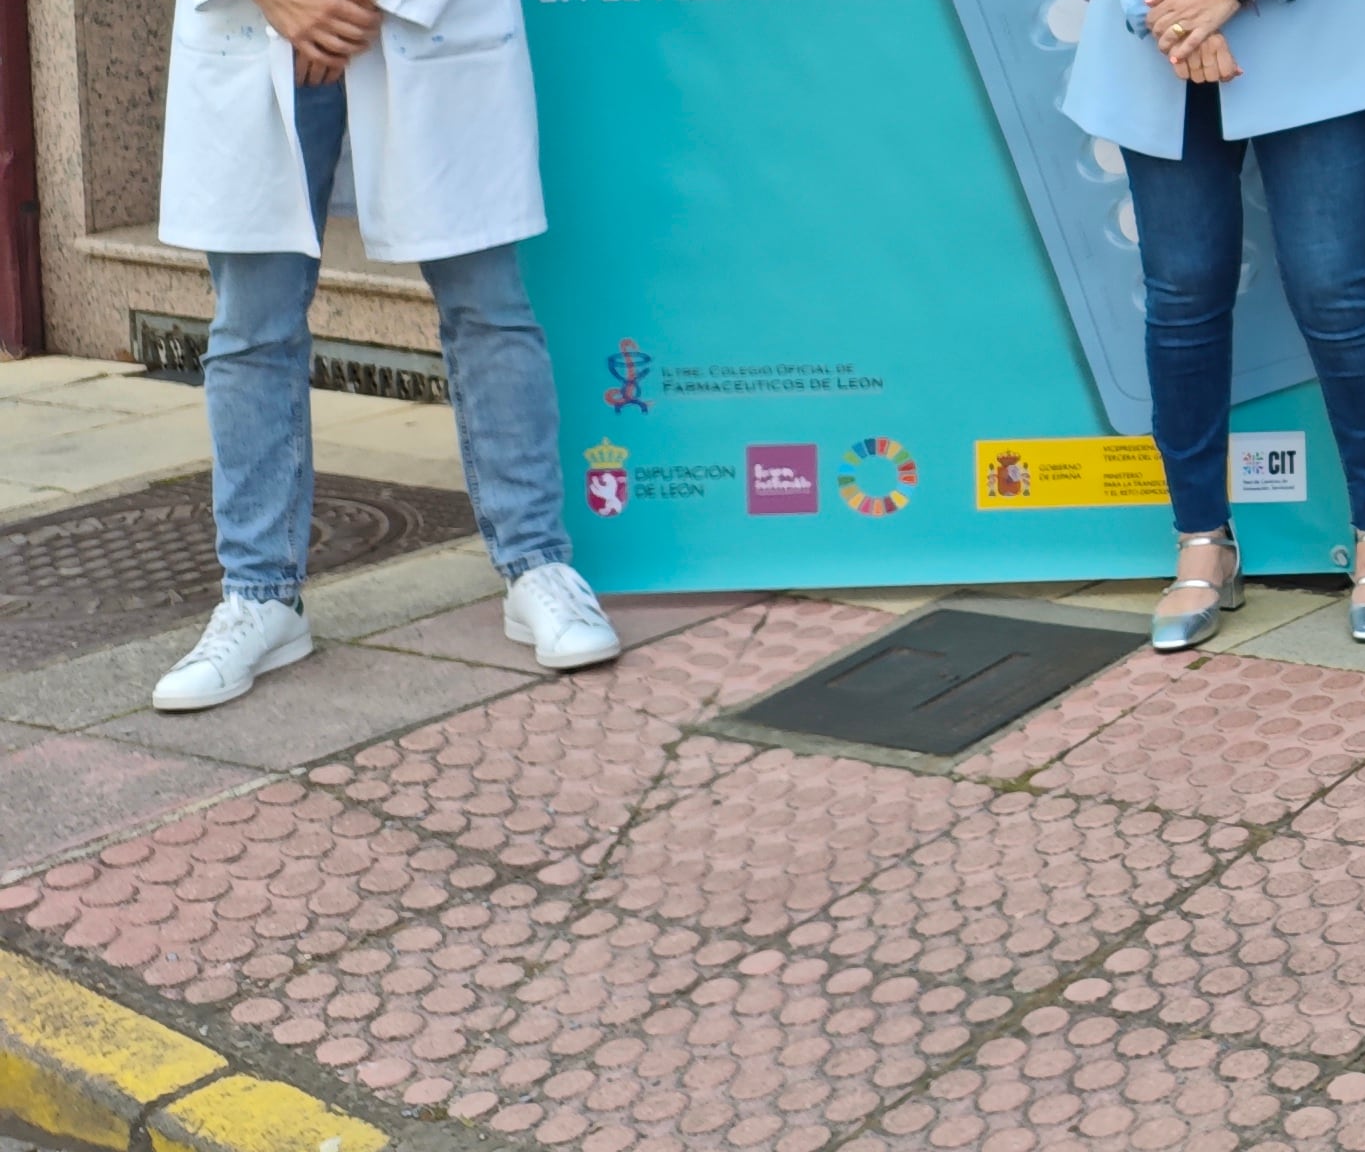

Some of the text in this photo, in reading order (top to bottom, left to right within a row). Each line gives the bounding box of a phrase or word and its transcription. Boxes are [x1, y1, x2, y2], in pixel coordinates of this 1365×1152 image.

[809, 377, 830, 390] DE
[1268, 450, 1297, 476] CIT
[635, 482, 656, 499] DE
